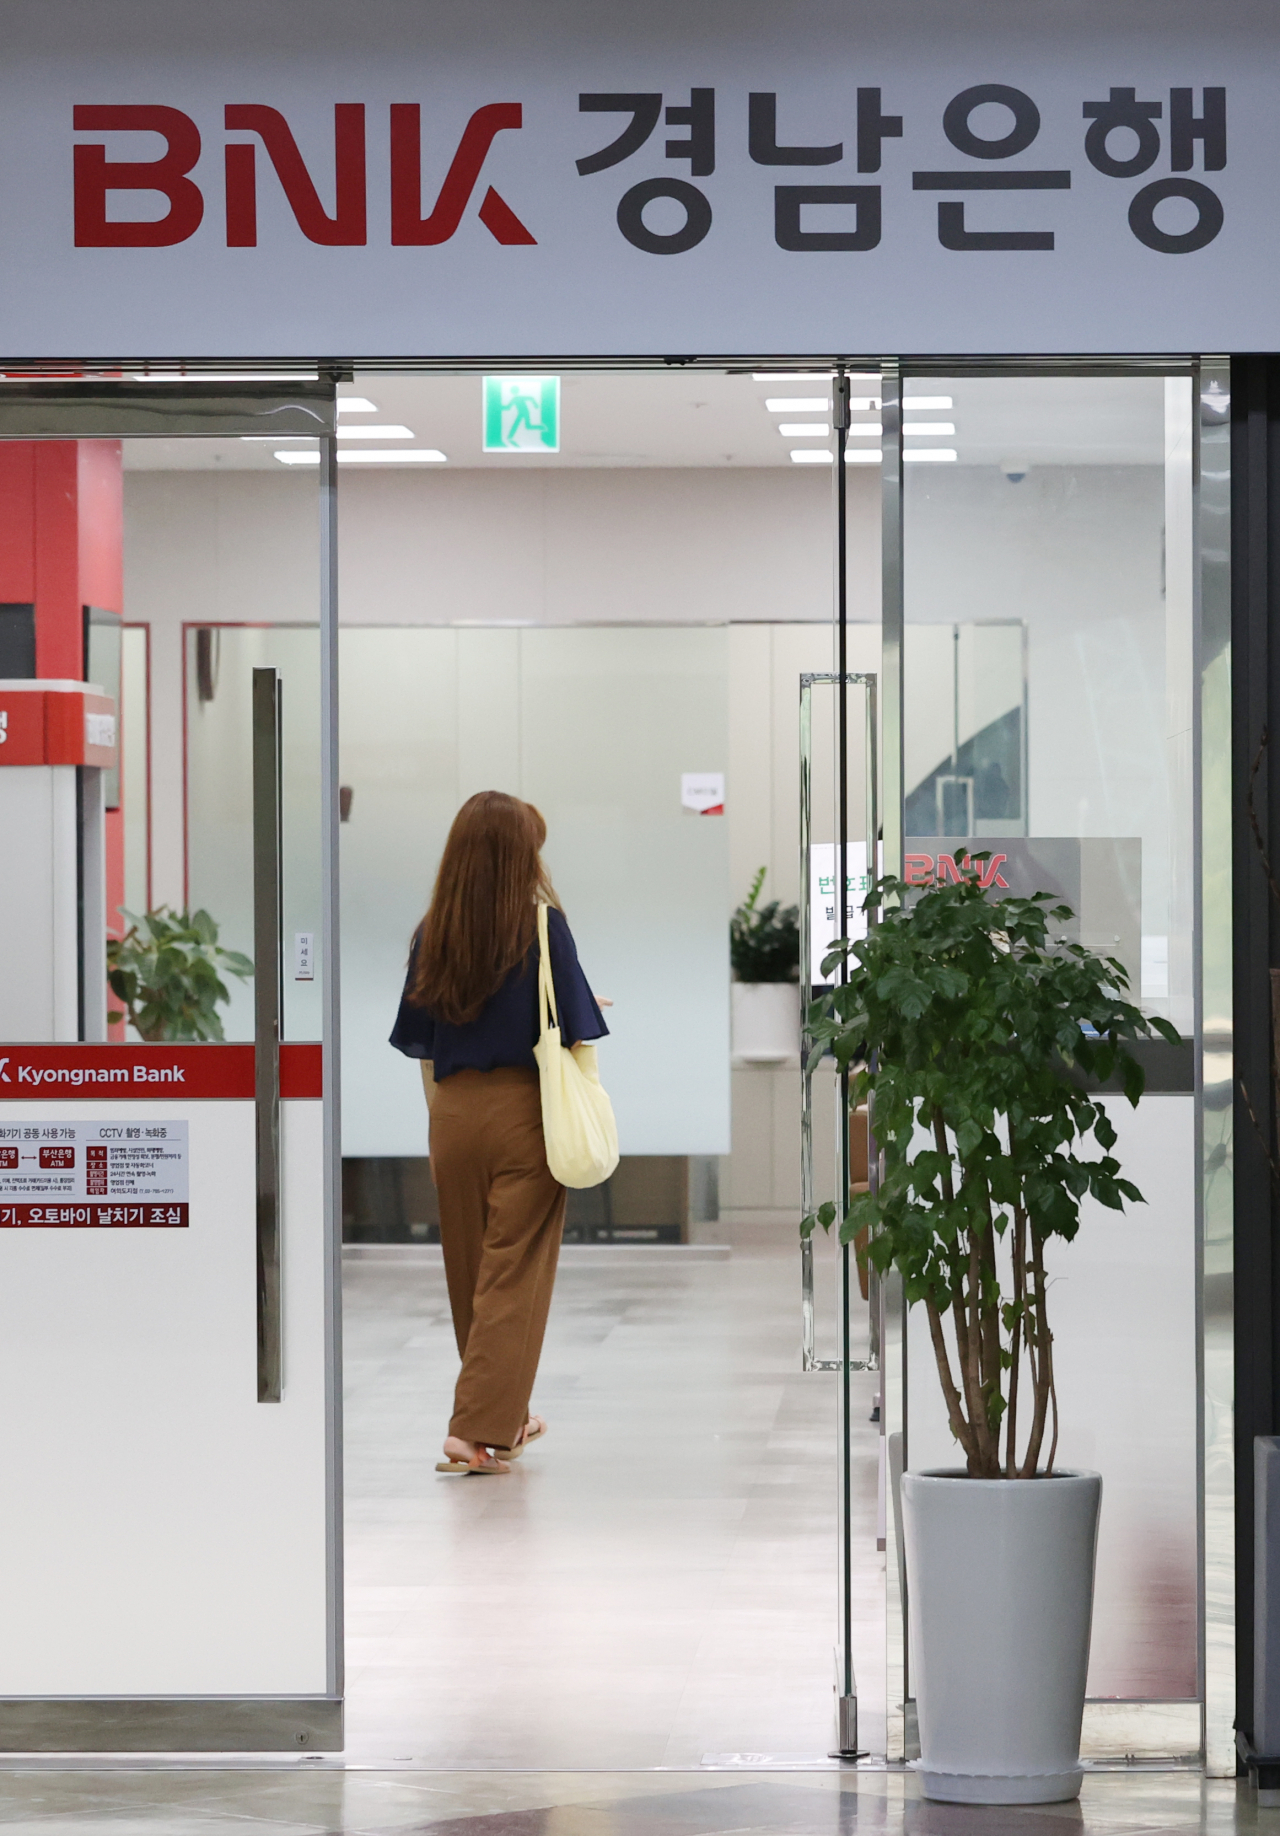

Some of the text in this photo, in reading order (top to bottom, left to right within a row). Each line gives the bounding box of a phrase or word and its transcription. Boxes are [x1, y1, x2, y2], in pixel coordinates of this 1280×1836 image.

[73, 83, 1227, 255] BNK 경남은행
[904, 854, 1009, 888] BNK
[17, 1065, 129, 1086] Kyongnam
[133, 1065, 186, 1083] Bank
[23, 1128, 40, 1139] 공동
[42, 1128, 58, 1139] 사용
[59, 1128, 76, 1139] 가능
[99, 1128, 123, 1139] CCTV
[0, 1149, 16, 1160] 은행
[42, 1149, 72, 1159] 부산은행
[28, 1207, 91, 1224] 오토바이
[97, 1207, 144, 1225] 날치기
[149, 1207, 181, 1225] 조심
